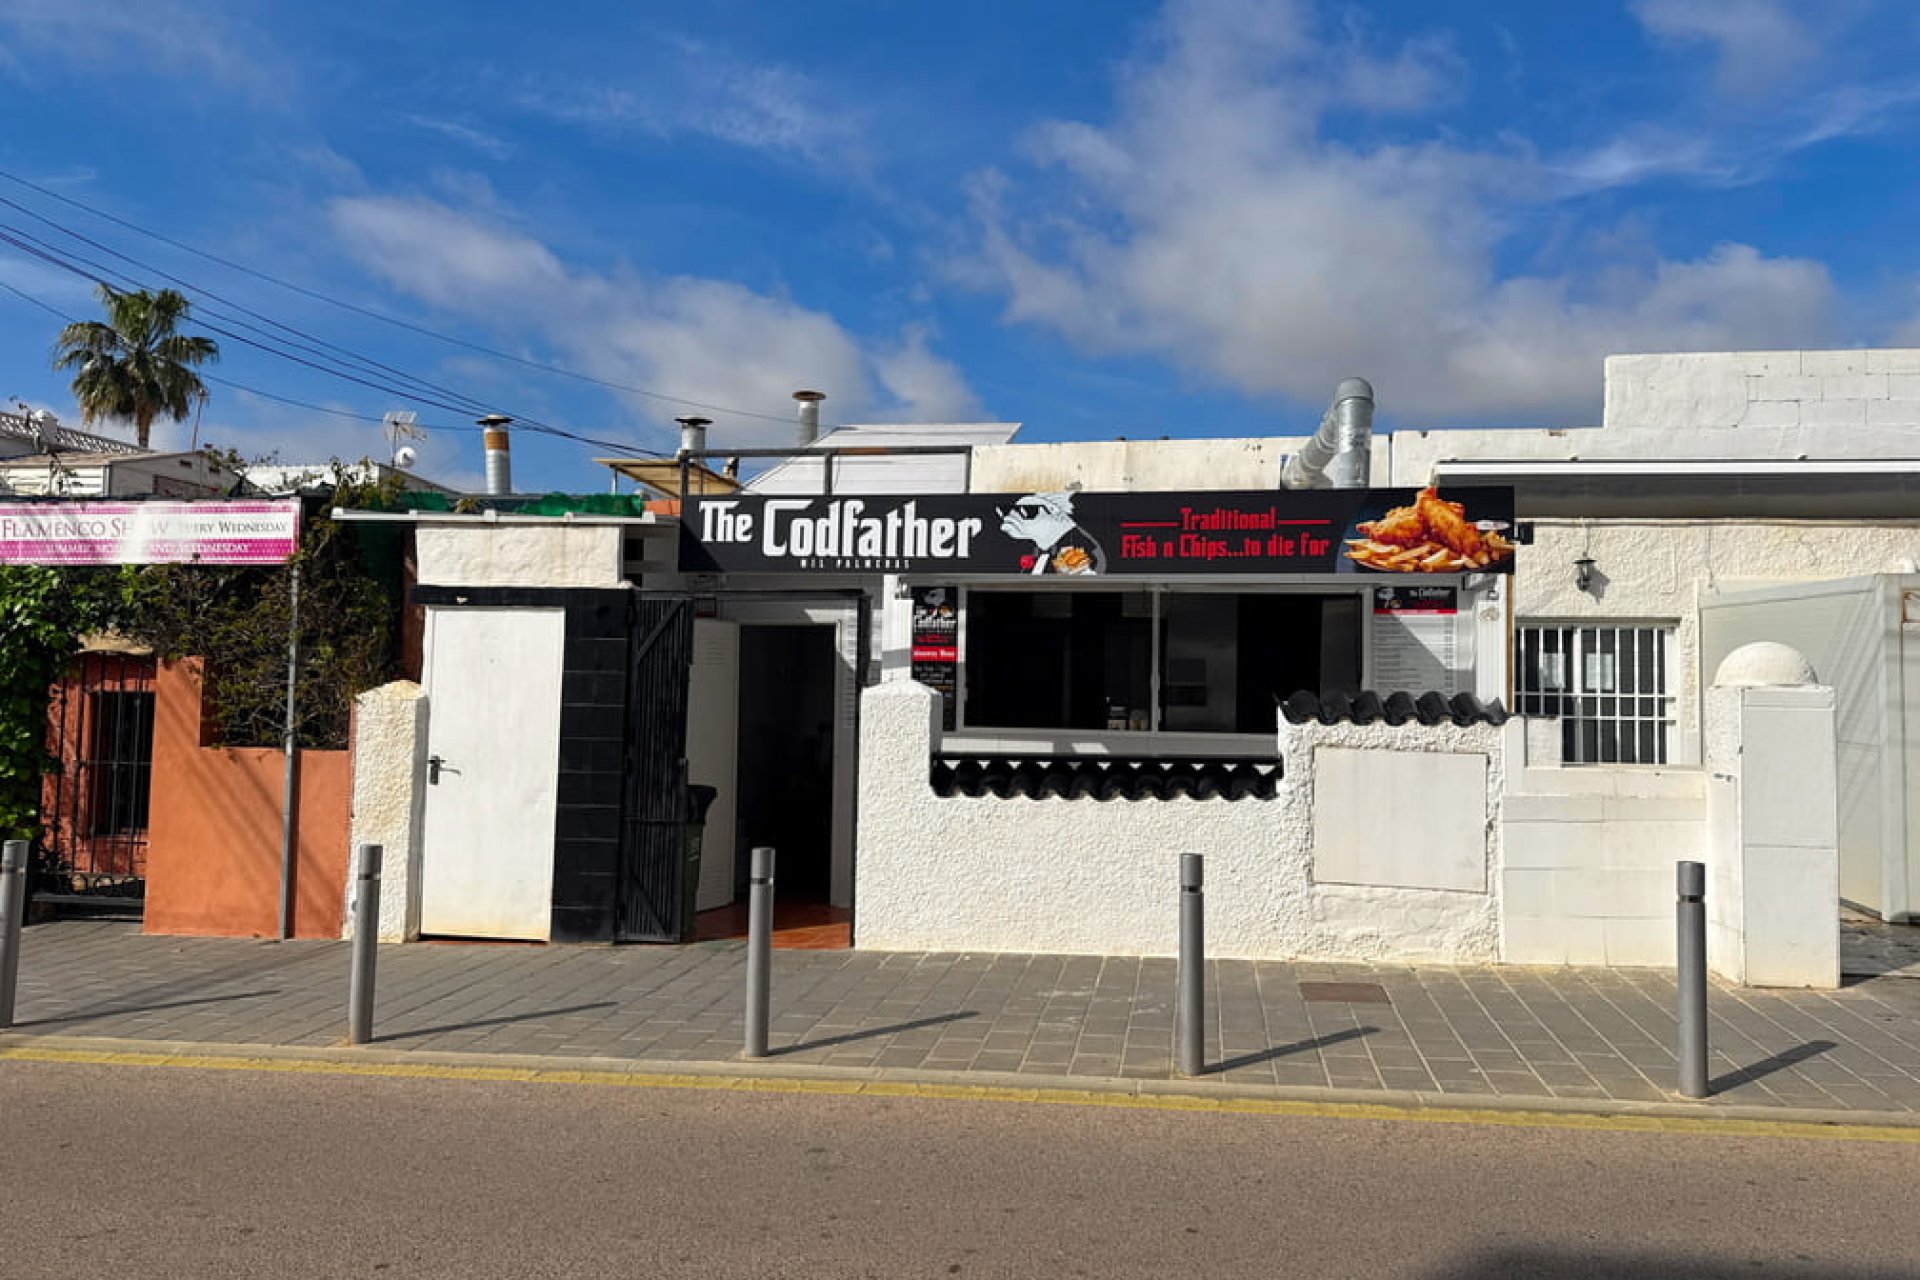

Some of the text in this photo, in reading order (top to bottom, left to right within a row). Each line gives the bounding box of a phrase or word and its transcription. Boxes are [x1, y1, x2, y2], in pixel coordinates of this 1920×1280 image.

[2, 518, 106, 538] FLAMENCO
[699, 500, 983, 557] The Codfather
[1180, 507, 1276, 530] Traditional
[1121, 535, 1156, 558] Fish
[1162, 541, 1174, 558] n
[1266, 534, 1294, 555] die
[1300, 532, 1331, 556] for
